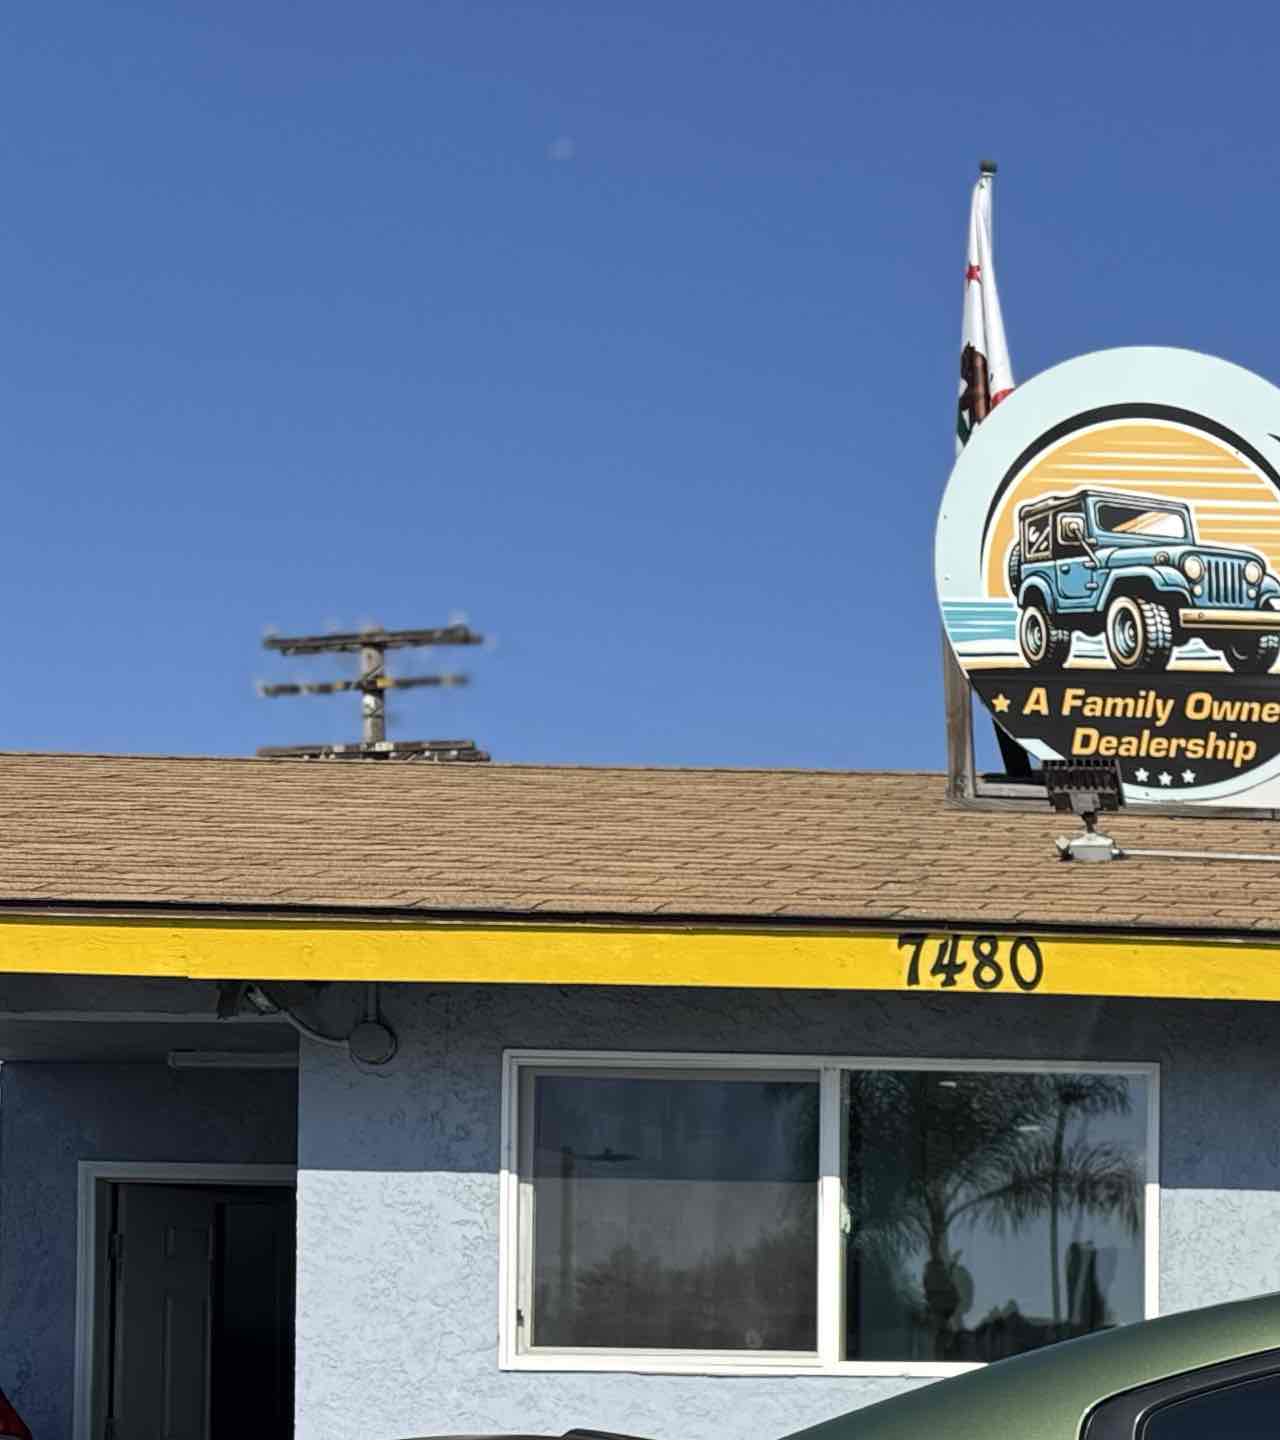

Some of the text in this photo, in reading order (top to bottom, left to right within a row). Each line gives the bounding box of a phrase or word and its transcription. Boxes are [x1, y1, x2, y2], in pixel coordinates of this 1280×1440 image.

[1022, 686, 1050, 717] A
[1060, 687, 1175, 727] Family
[1071, 726, 1258, 769] Dealership
[896, 932, 1044, 991] 7480
